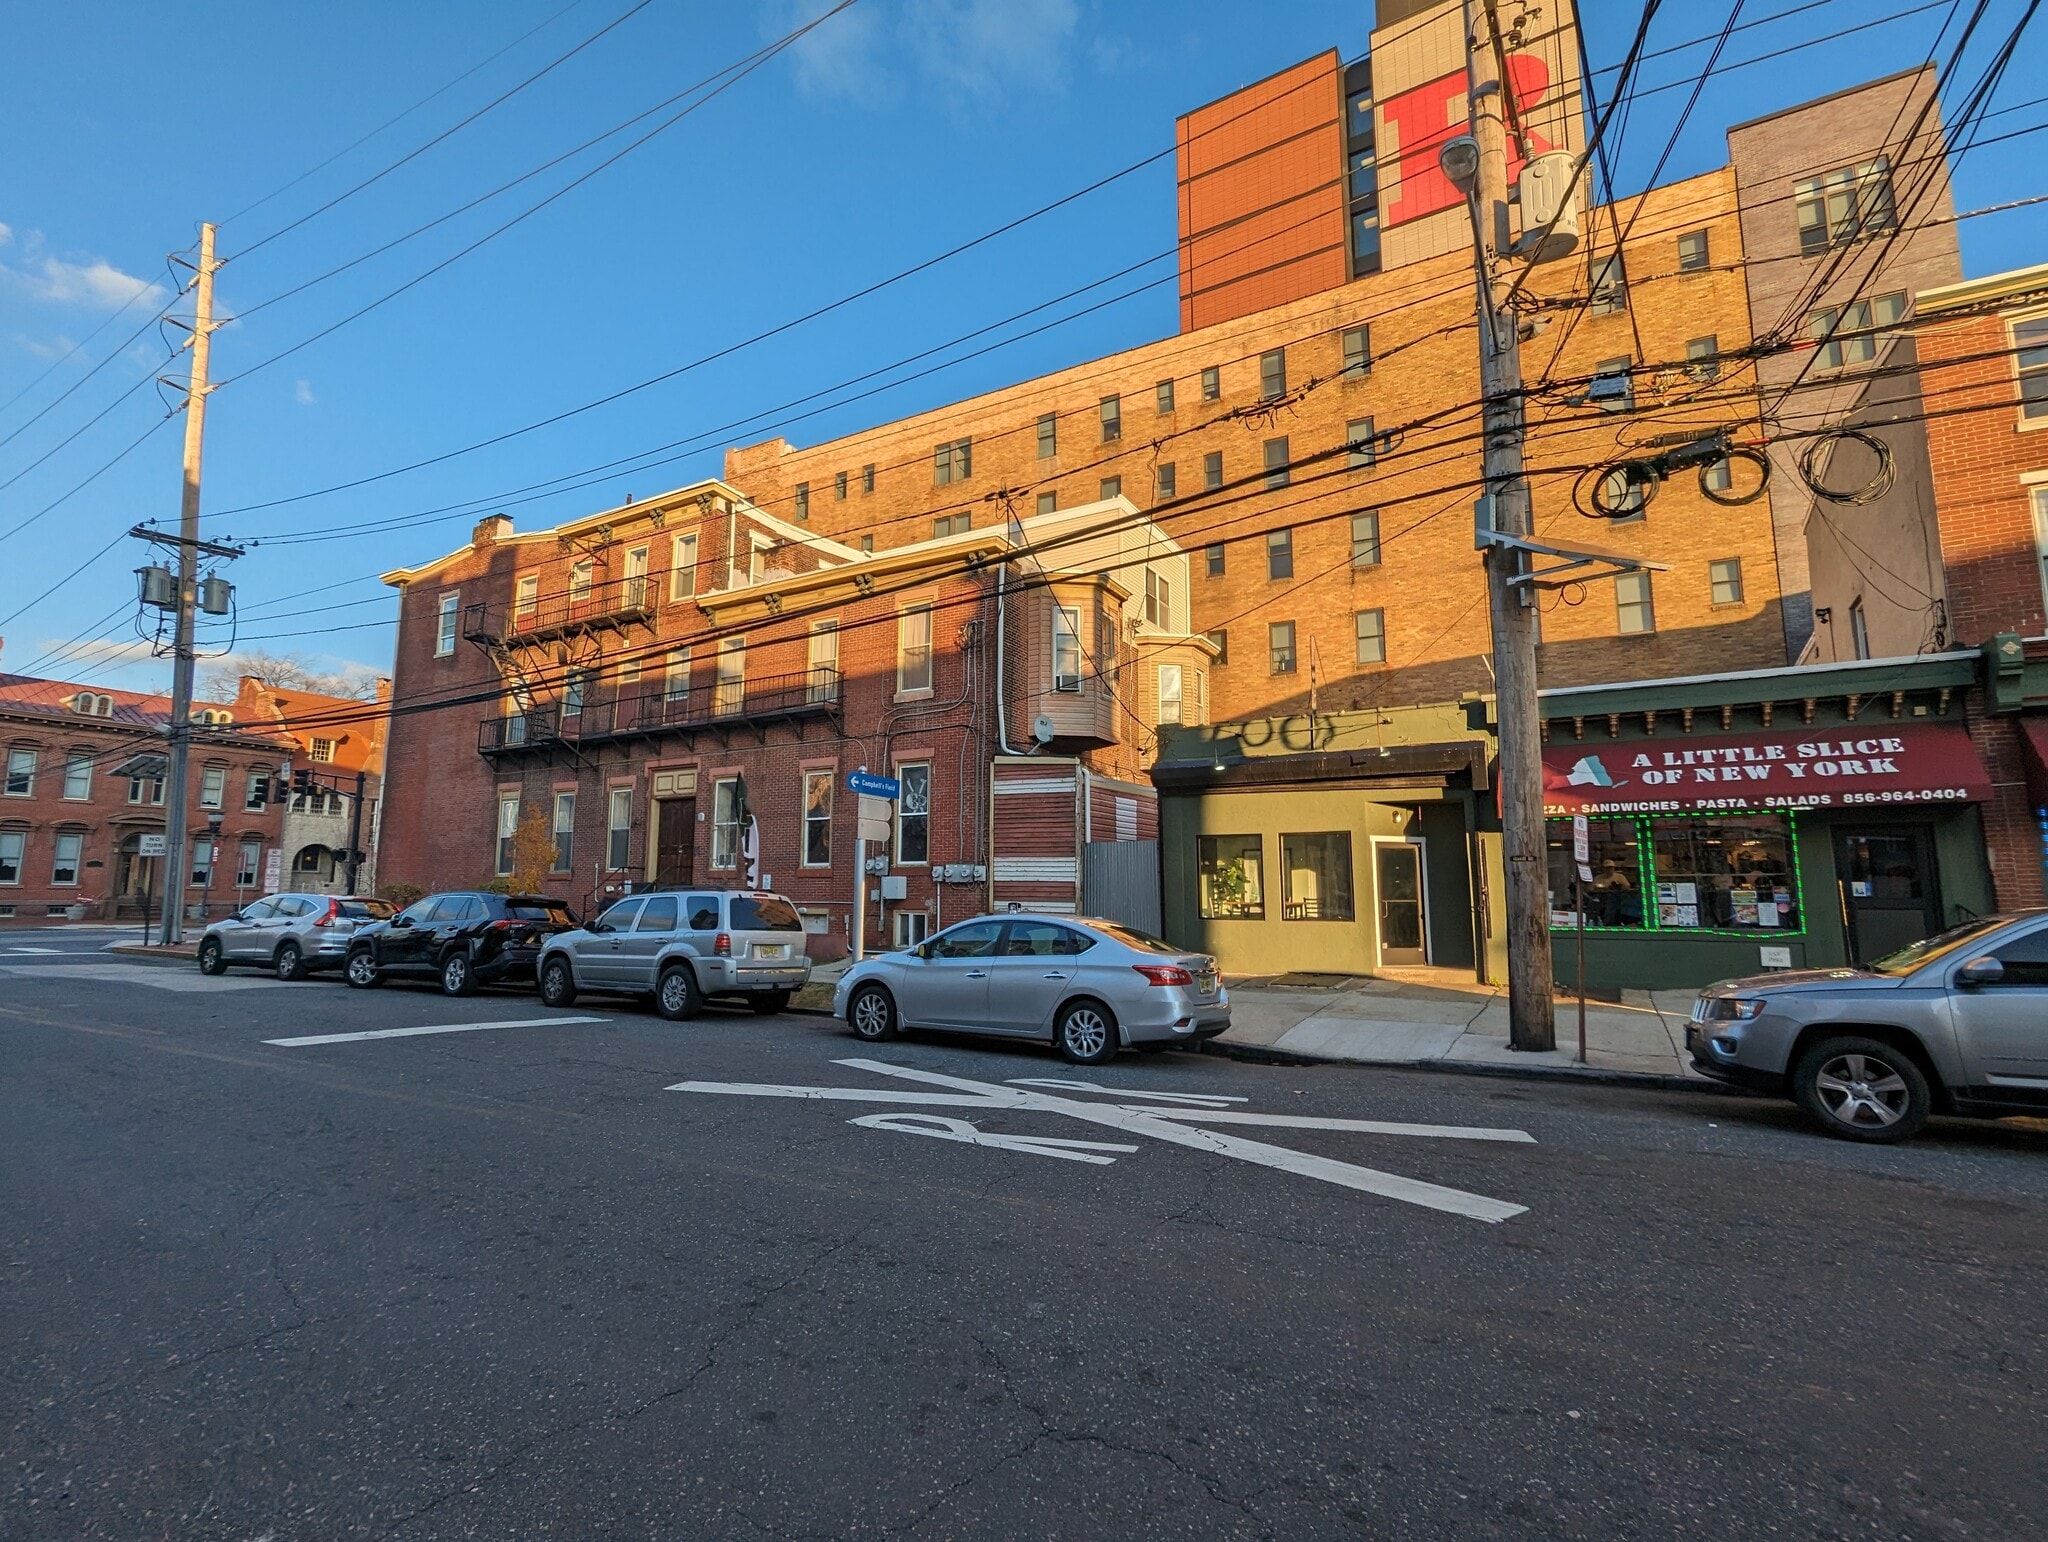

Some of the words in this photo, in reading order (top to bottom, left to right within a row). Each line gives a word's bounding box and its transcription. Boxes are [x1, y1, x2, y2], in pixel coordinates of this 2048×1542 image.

[1383, 54, 1564, 226] R
[1631, 753, 1653, 768] A
[1663, 745, 1786, 766] LITTLE
[1796, 737, 1905, 759] SLICE
[1642, 769, 1683, 785] OF
[1694, 764, 1772, 783] NEW
[1784, 757, 1900, 778] YORK
[861, 779, 885, 790] Campbell's
[885, 783, 896, 792] Field
[1543, 805, 1567, 815] ZZA
[1581, 800, 1680, 814] SANDWICHES
[1697, 798, 1748, 809] PASTA
[1765, 794, 1831, 807] SALADS
[1843, 788, 1968, 804] 856-964-0404
